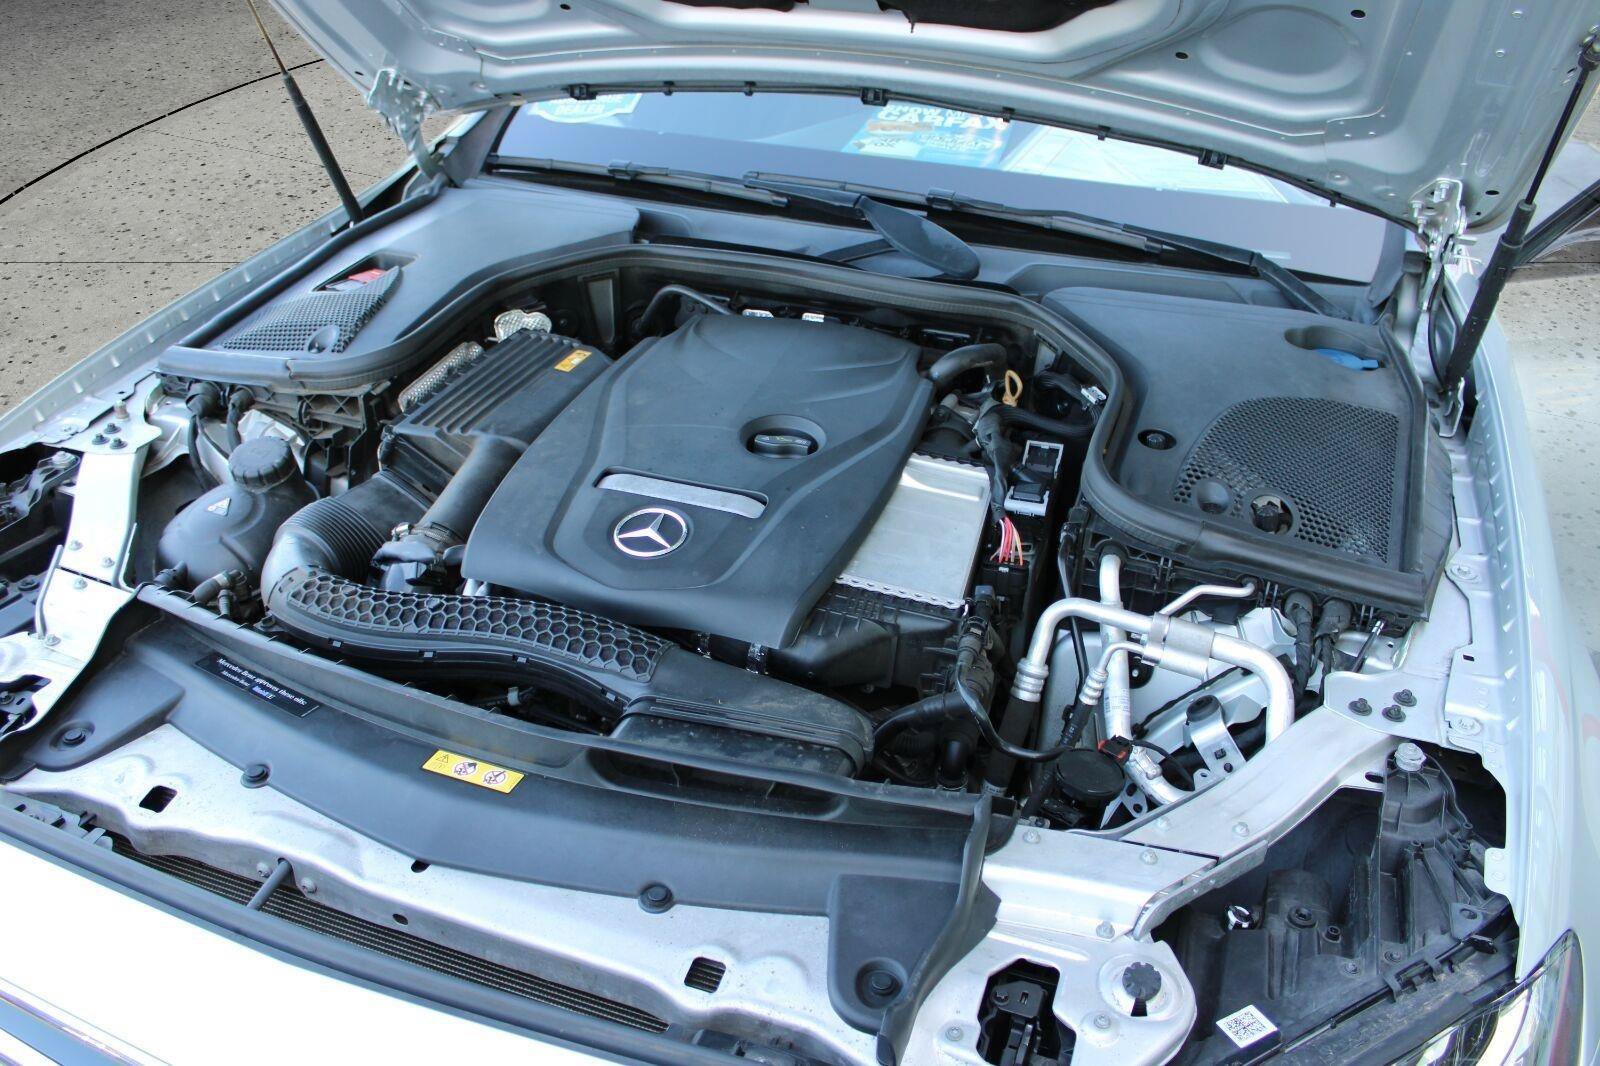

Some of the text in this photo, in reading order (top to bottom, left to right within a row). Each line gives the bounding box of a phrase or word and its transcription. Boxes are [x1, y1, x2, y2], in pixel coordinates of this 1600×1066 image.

[553, 103, 605, 117] DEALER
[882, 104, 938, 118] SHOW
[877, 110, 1010, 131] CARFAX
